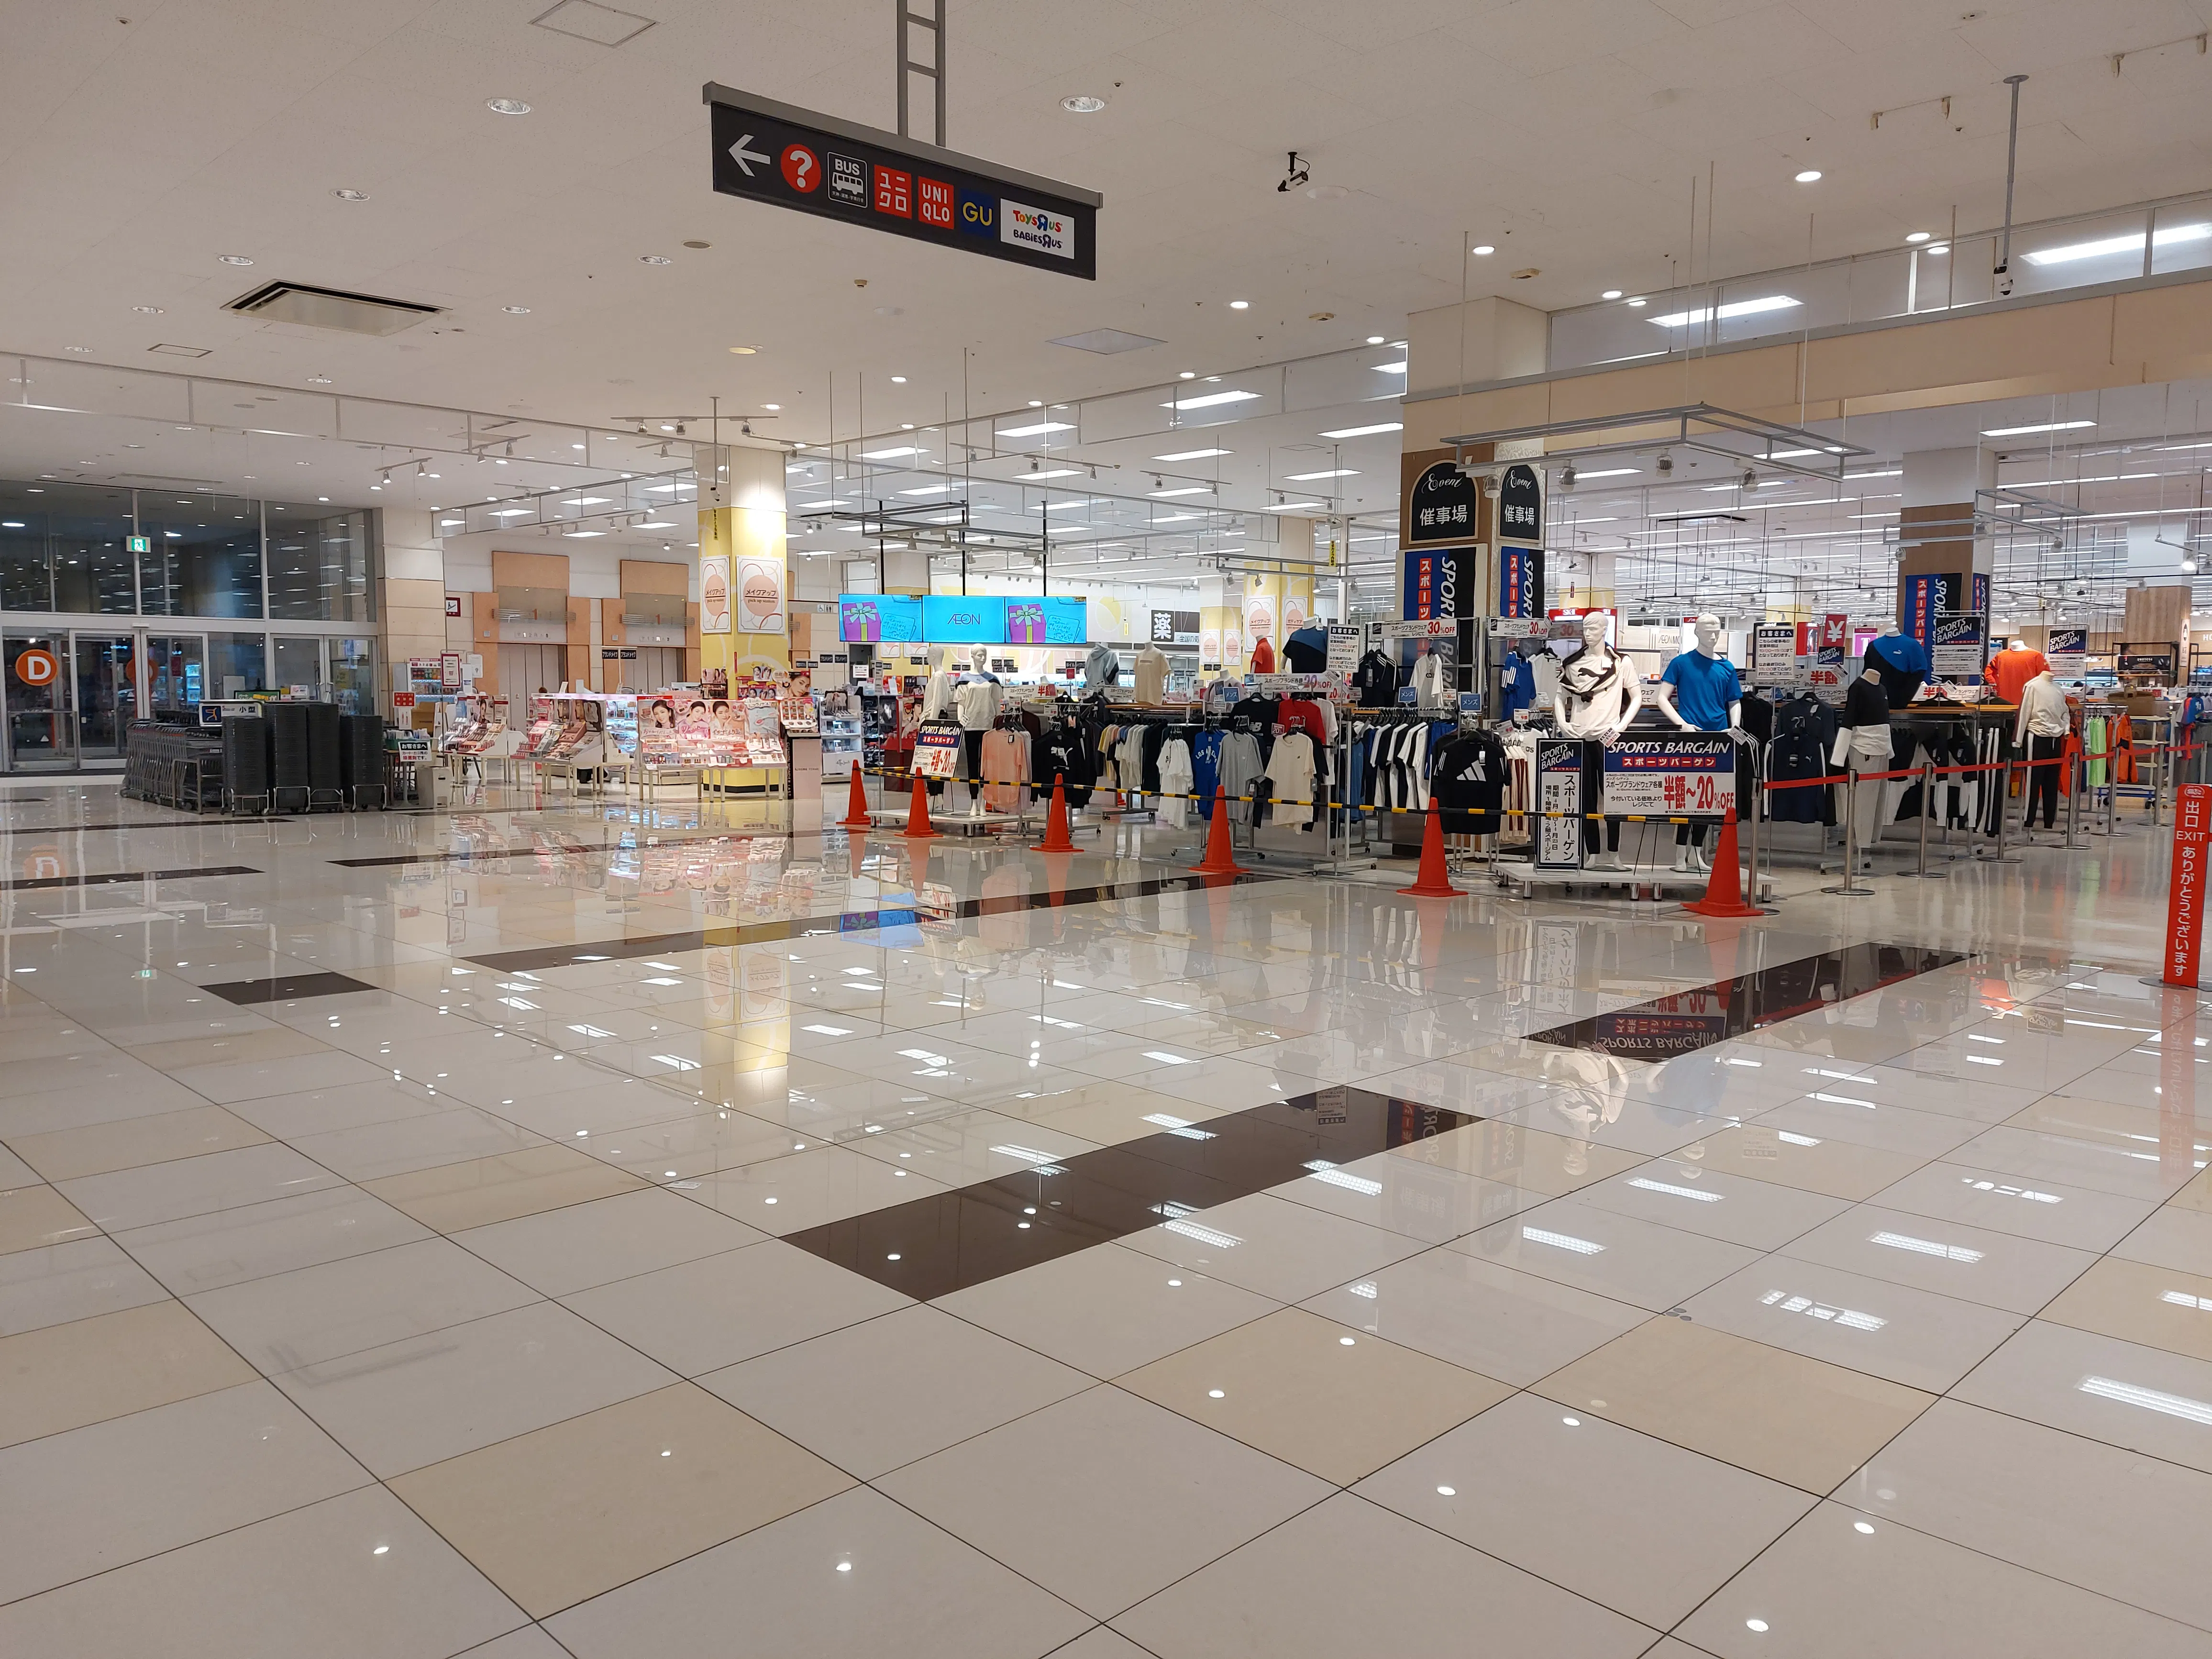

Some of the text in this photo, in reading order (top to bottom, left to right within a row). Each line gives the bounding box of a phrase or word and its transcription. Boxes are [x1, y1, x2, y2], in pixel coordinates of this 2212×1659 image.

[835, 158, 860, 176] BUS
[963, 202, 992, 226] GU
[1422, 473, 1462, 494] Event
[1506, 470, 1533, 489] Event
[1420, 505, 1468, 526] 催事場
[1505, 504, 1535, 525] 催事場
[1154, 613, 1172, 639] 薬
[1936, 618, 1966, 635] SPORTS
[1937, 623, 1972, 643] BARGAIN
[2050, 630, 2075, 646] SPORTS
[2050, 635, 2079, 653] BARGAIN
[1819, 647, 1836, 657] SPORTS
[1819, 651, 1840, 663] BARGAIN
[28, 657, 51, 680] D
[920, 726, 962, 736] SPORTS BARGAIN
[1541, 743, 1568, 762] SPORTS
[1608, 741, 1730, 754] SPORTS BARGAIN
[1542, 749, 1574, 770] BARGAIN
[1624, 758, 1715, 766] スポーツバーゲン
[2185, 801, 2200, 828] 出口
[2176, 830, 2206, 841] EXIT
[2174, 846, 2196, 977] ありがとうございます
